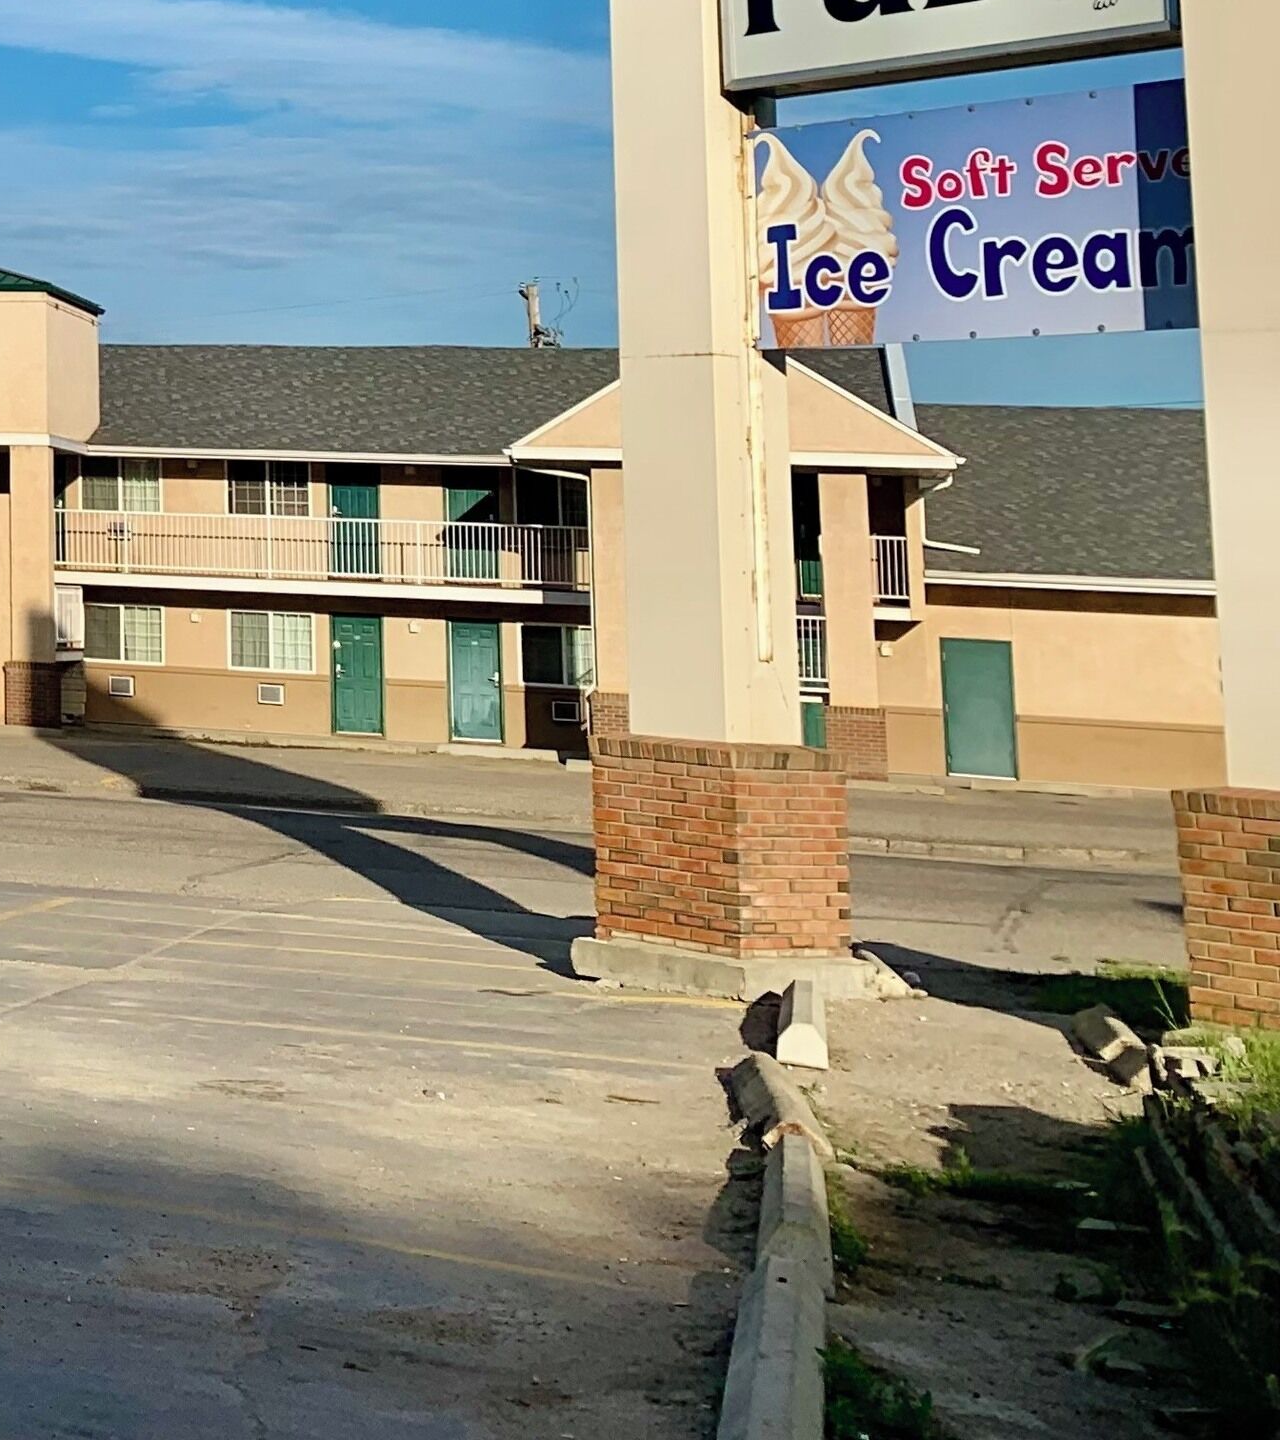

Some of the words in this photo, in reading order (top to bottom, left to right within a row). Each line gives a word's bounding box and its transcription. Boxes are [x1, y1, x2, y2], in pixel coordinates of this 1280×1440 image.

[900, 147, 1017, 210] Soft
[1033, 140, 1191, 198] Serve
[765, 221, 892, 313] Ice
[927, 205, 1196, 302] Cream
